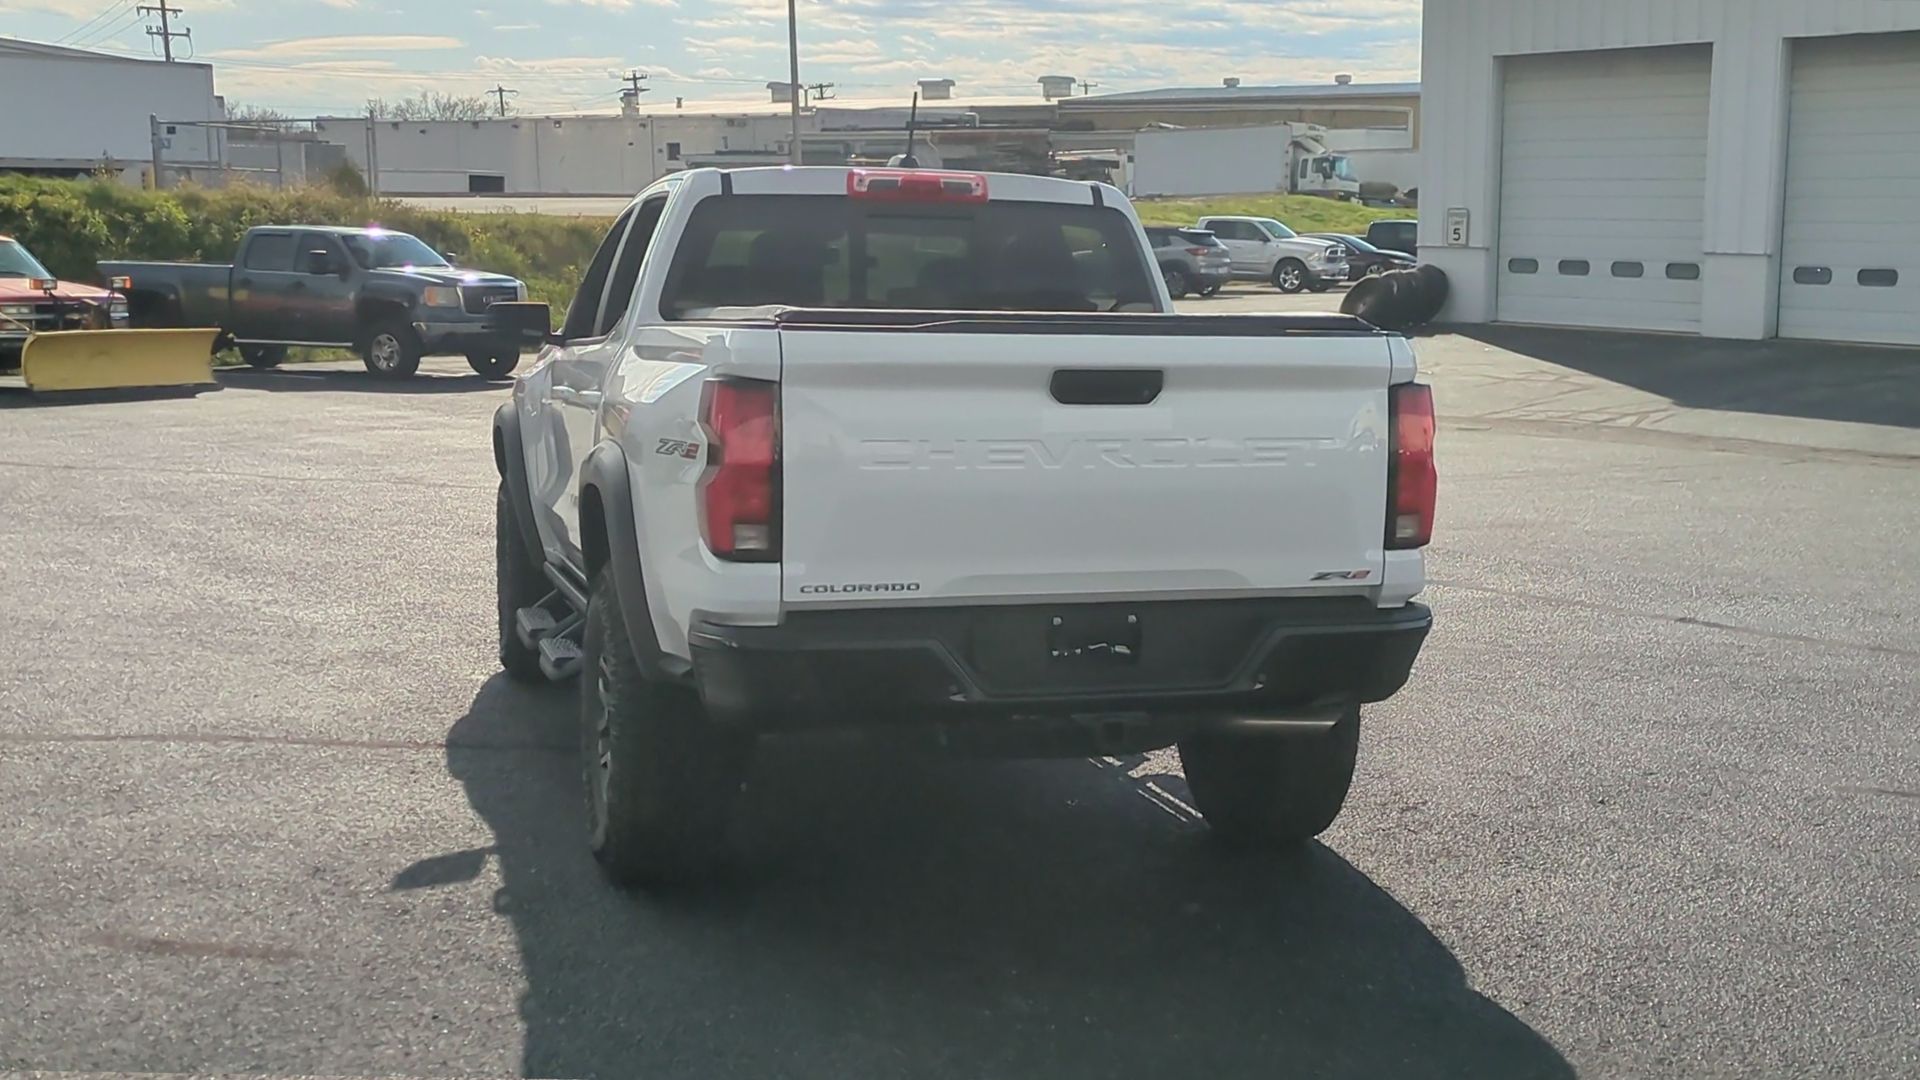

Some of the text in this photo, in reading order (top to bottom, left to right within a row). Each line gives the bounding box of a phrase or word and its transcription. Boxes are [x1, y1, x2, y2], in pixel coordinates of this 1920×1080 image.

[1453, 227, 1461, 241] 5
[859, 437, 1335, 470] CHEVROLET
[799, 582, 920, 594] COLORADO
